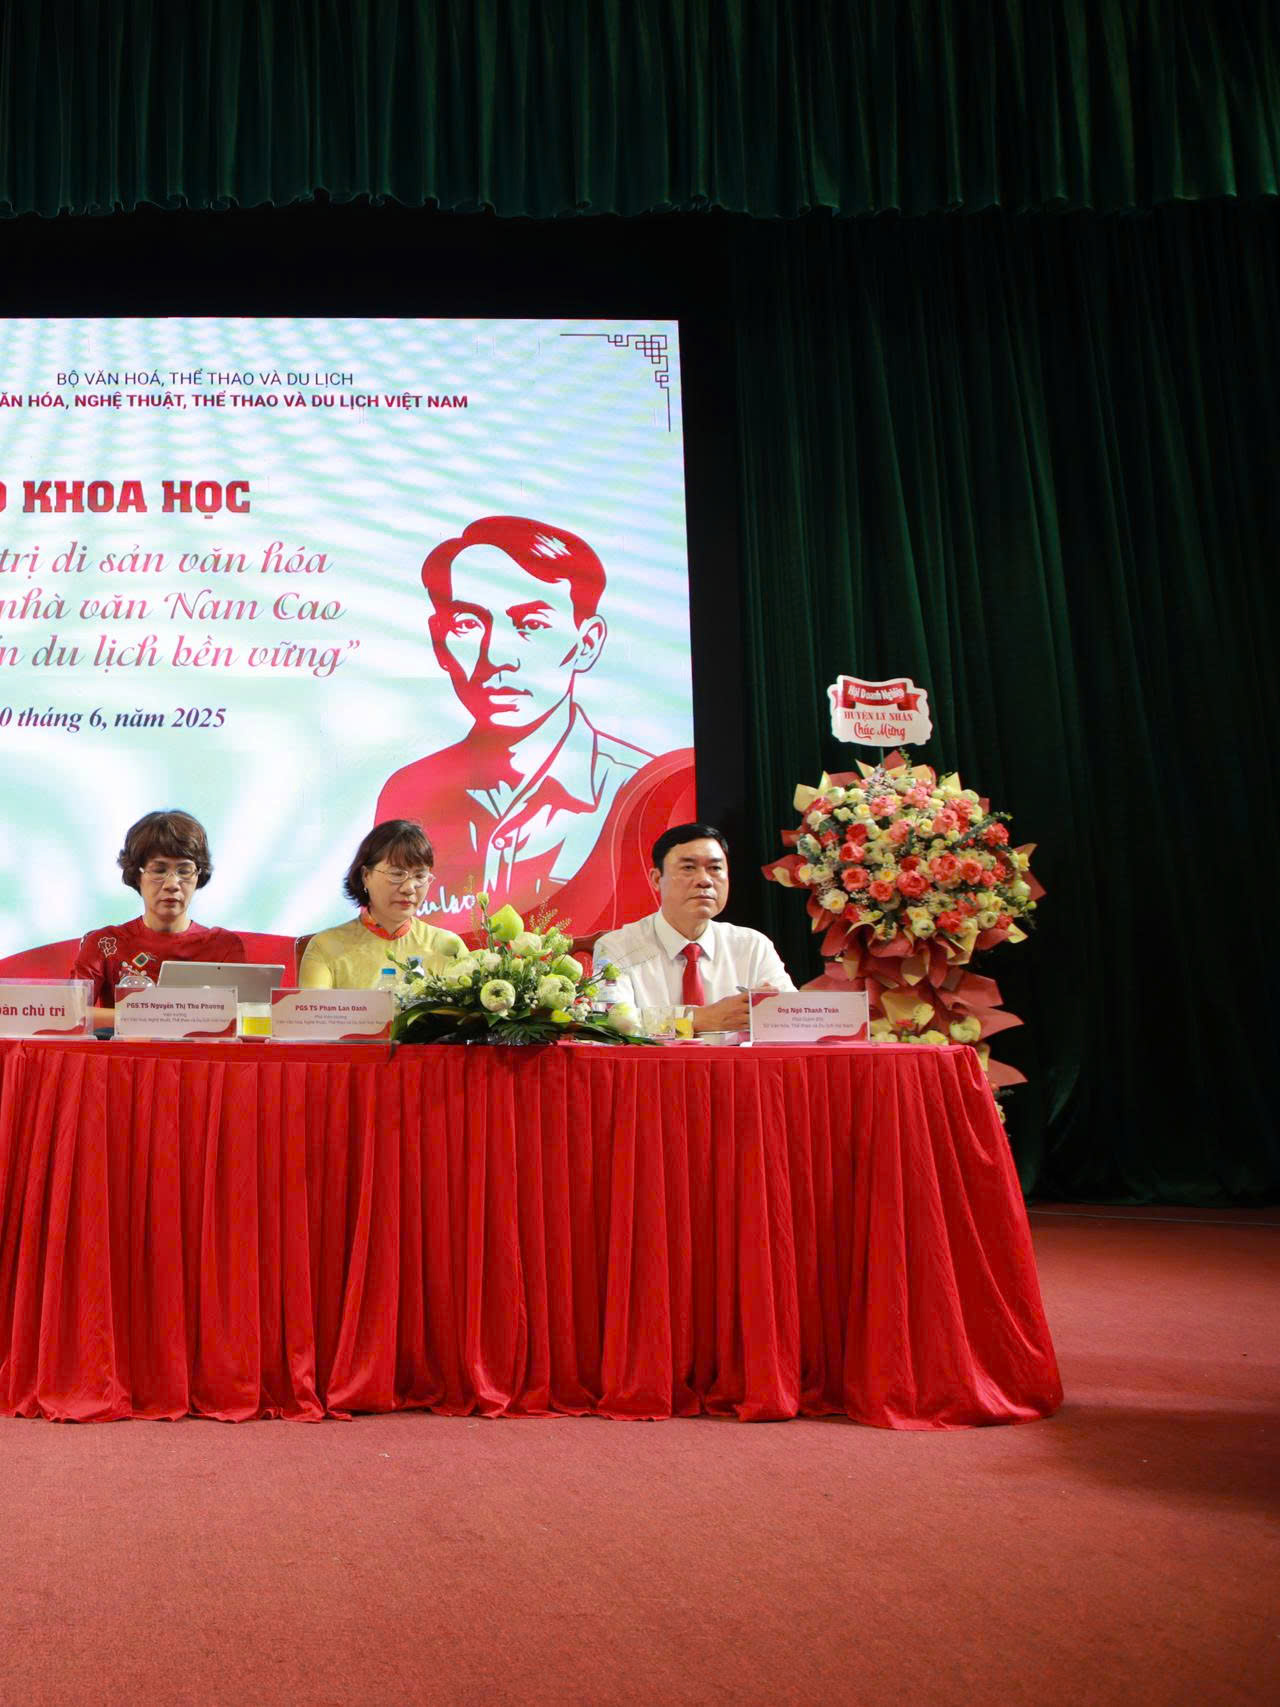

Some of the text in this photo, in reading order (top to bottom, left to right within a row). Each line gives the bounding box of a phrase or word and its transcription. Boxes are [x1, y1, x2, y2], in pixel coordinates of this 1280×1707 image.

[58, 368, 353, 389] BỘ VĂN HOÁ, THỂ THAO VÀ DU LỊCH
[29, 392, 69, 409] HÓA,
[75, 392, 121, 409] NGHỆ
[127, 392, 186, 409] THUẬT,
[192, 391, 225, 406] THỂ
[230, 395, 278, 407] THAO
[284, 392, 306, 407] VÀ
[312, 395, 334, 407] DU
[340, 395, 379, 410] LỊCH
[385, 392, 422, 410] VIỆT
[428, 396, 467, 408] NAM
[23, 480, 147, 513] KHOA
[162, 481, 250, 519] HỌC
[52, 541, 91, 573] di
[99, 545, 168, 572] sản
[179, 549, 249, 573] văn
[261, 542, 331, 573] hóa
[80, 595, 150, 619] văn
[164, 589, 261, 620] Nam
[273, 593, 344, 620] Cao
[32, 635, 82, 666] du
[94, 635, 161, 672] lịch
[172, 635, 236, 667] bền
[18, 707, 83, 732] tháng
[89, 708, 107, 729] 6,
[114, 709, 164, 727] năm
[172, 708, 226, 727] 2025
